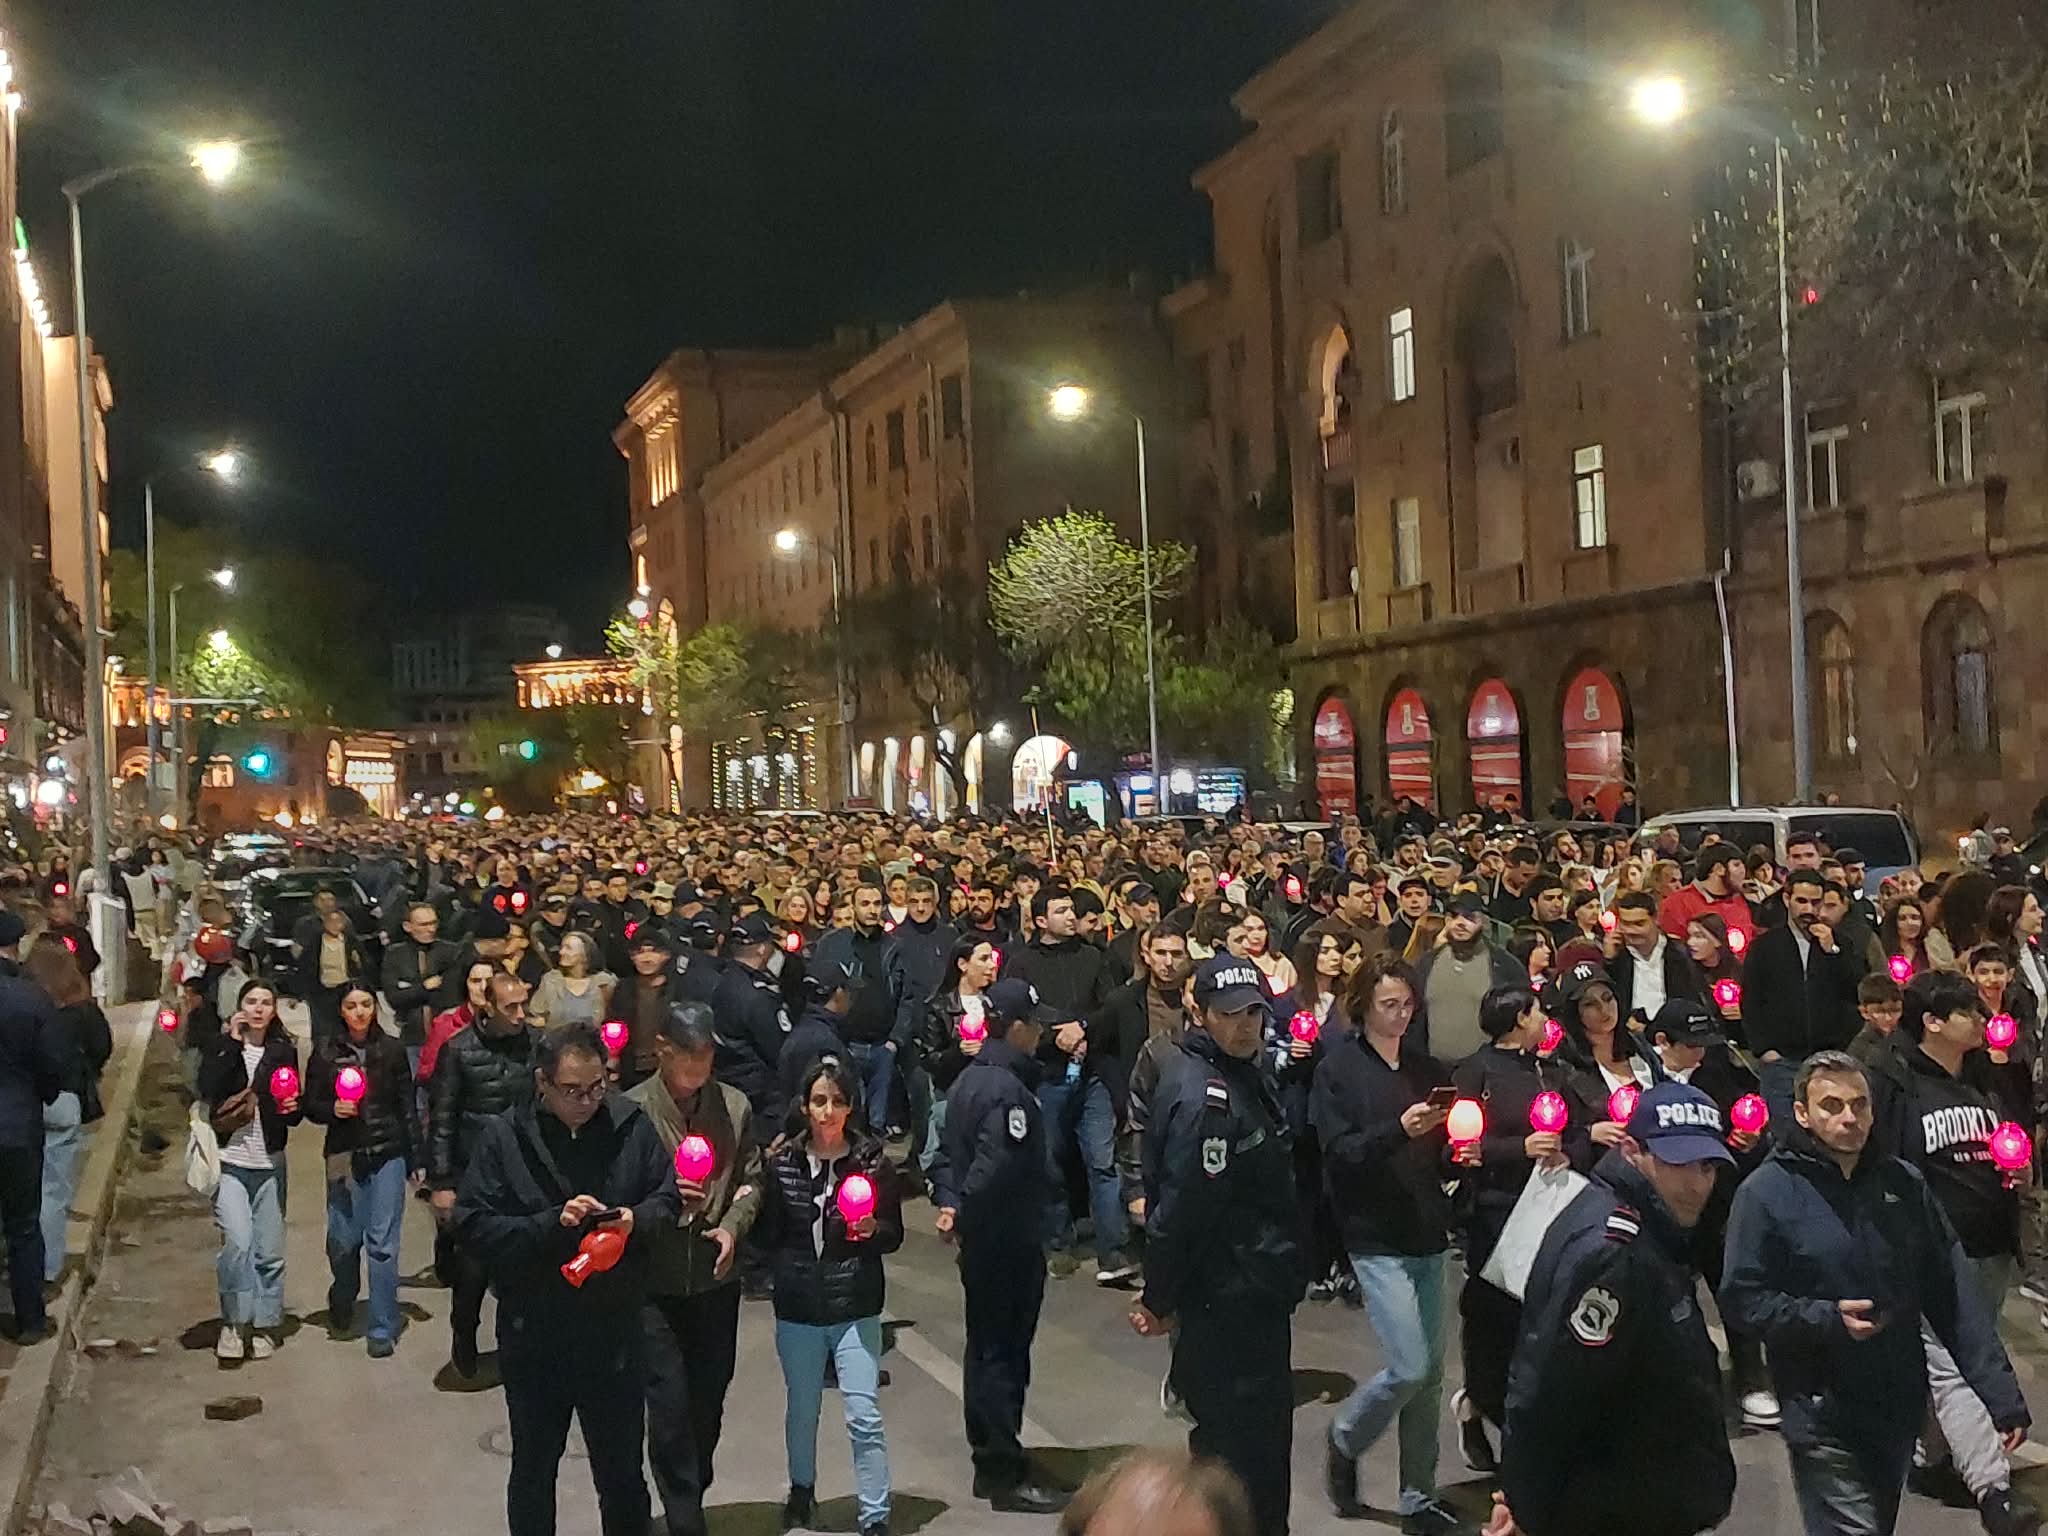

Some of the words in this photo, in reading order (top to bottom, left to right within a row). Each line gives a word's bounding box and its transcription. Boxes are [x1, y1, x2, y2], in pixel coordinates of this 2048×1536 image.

[1214, 967, 1260, 989] POLICE
[1655, 1102, 1723, 1132] POLICE
[1921, 1105, 2000, 1155] BROOKLY
